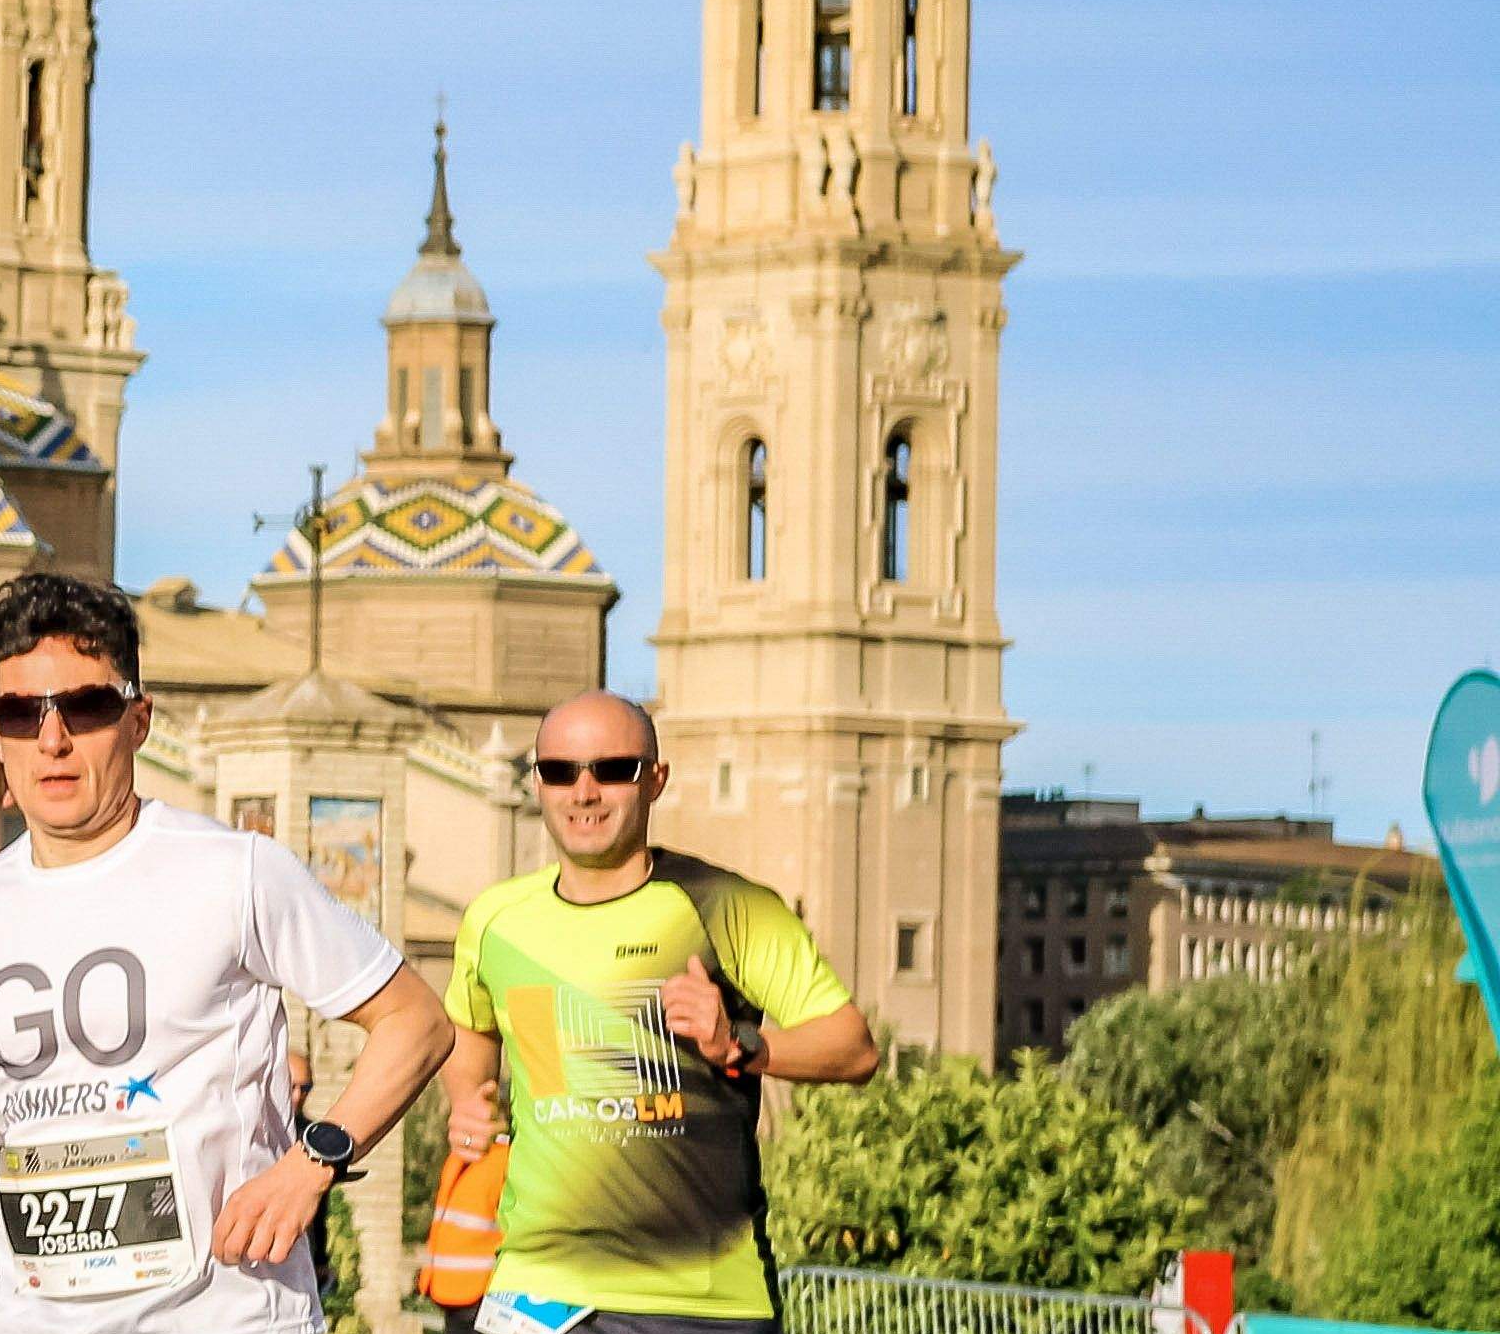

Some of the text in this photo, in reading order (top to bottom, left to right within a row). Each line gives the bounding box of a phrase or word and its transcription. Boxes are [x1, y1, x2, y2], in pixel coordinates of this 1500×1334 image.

[2, 1081, 108, 1125] RUNNERS
[20, 1182, 128, 1238] 2277
[38, 1230, 120, 1255] JOSERRA
